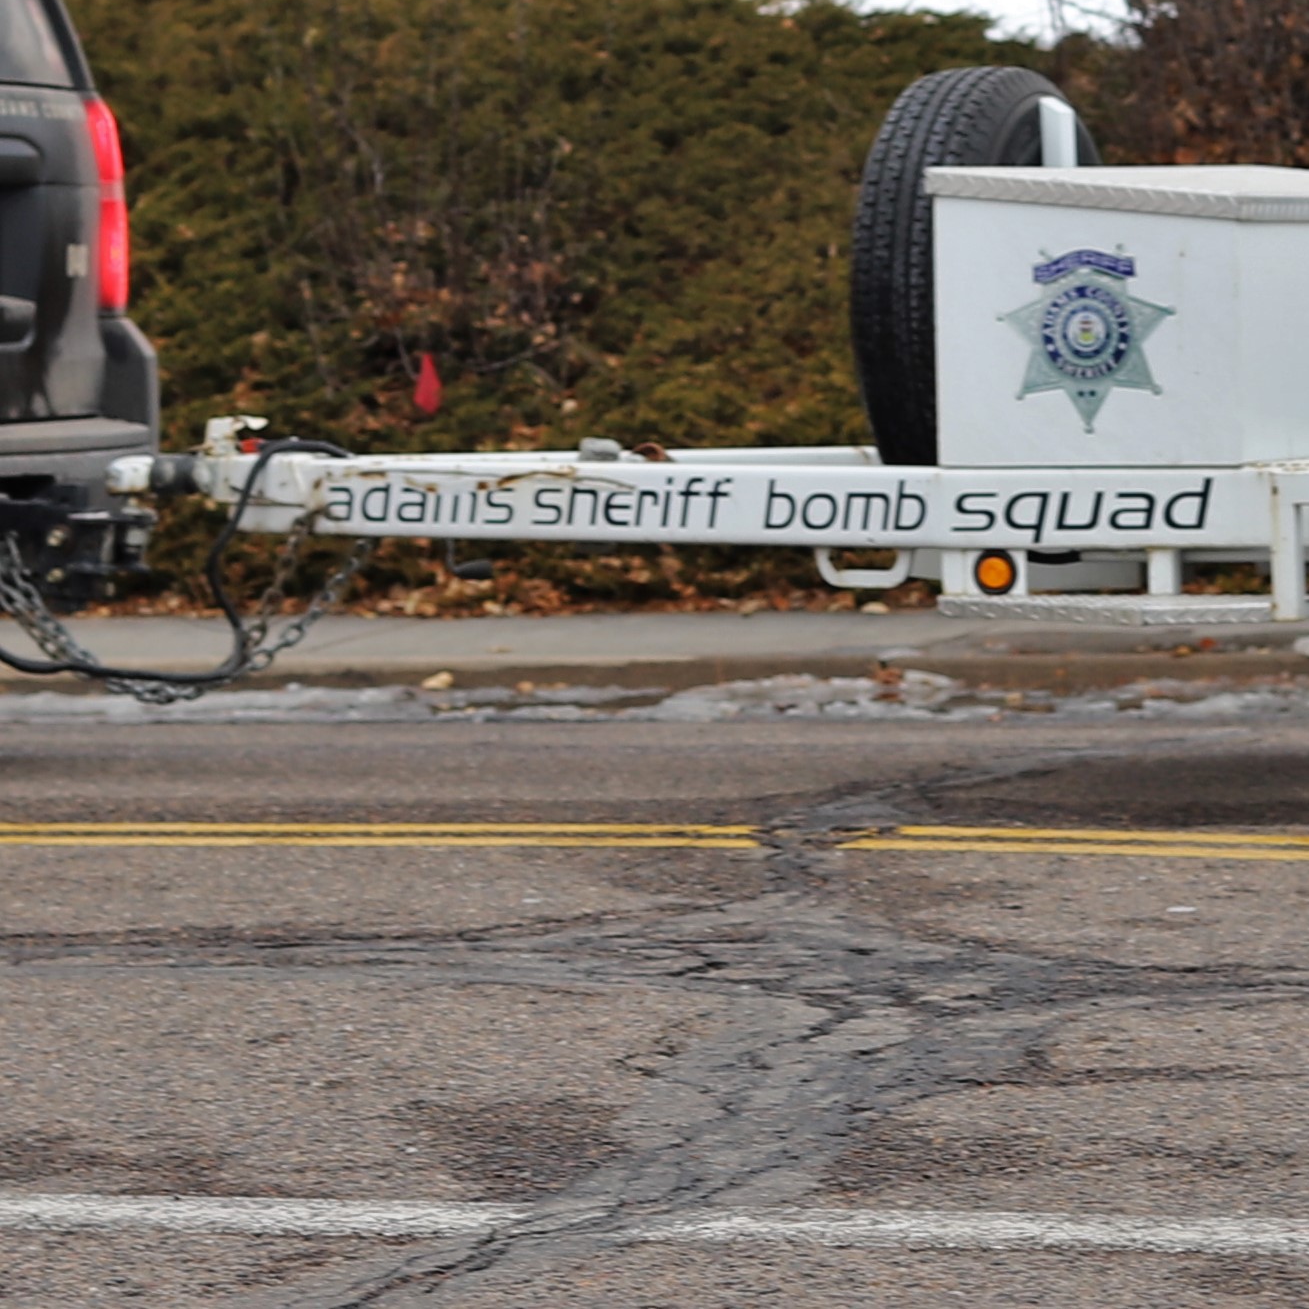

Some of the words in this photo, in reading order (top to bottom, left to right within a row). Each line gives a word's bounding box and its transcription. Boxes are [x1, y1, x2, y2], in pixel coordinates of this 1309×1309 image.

[531, 476, 733, 531] sheriff
[763, 478, 928, 531] bomb
[951, 477, 1214, 544] squad
